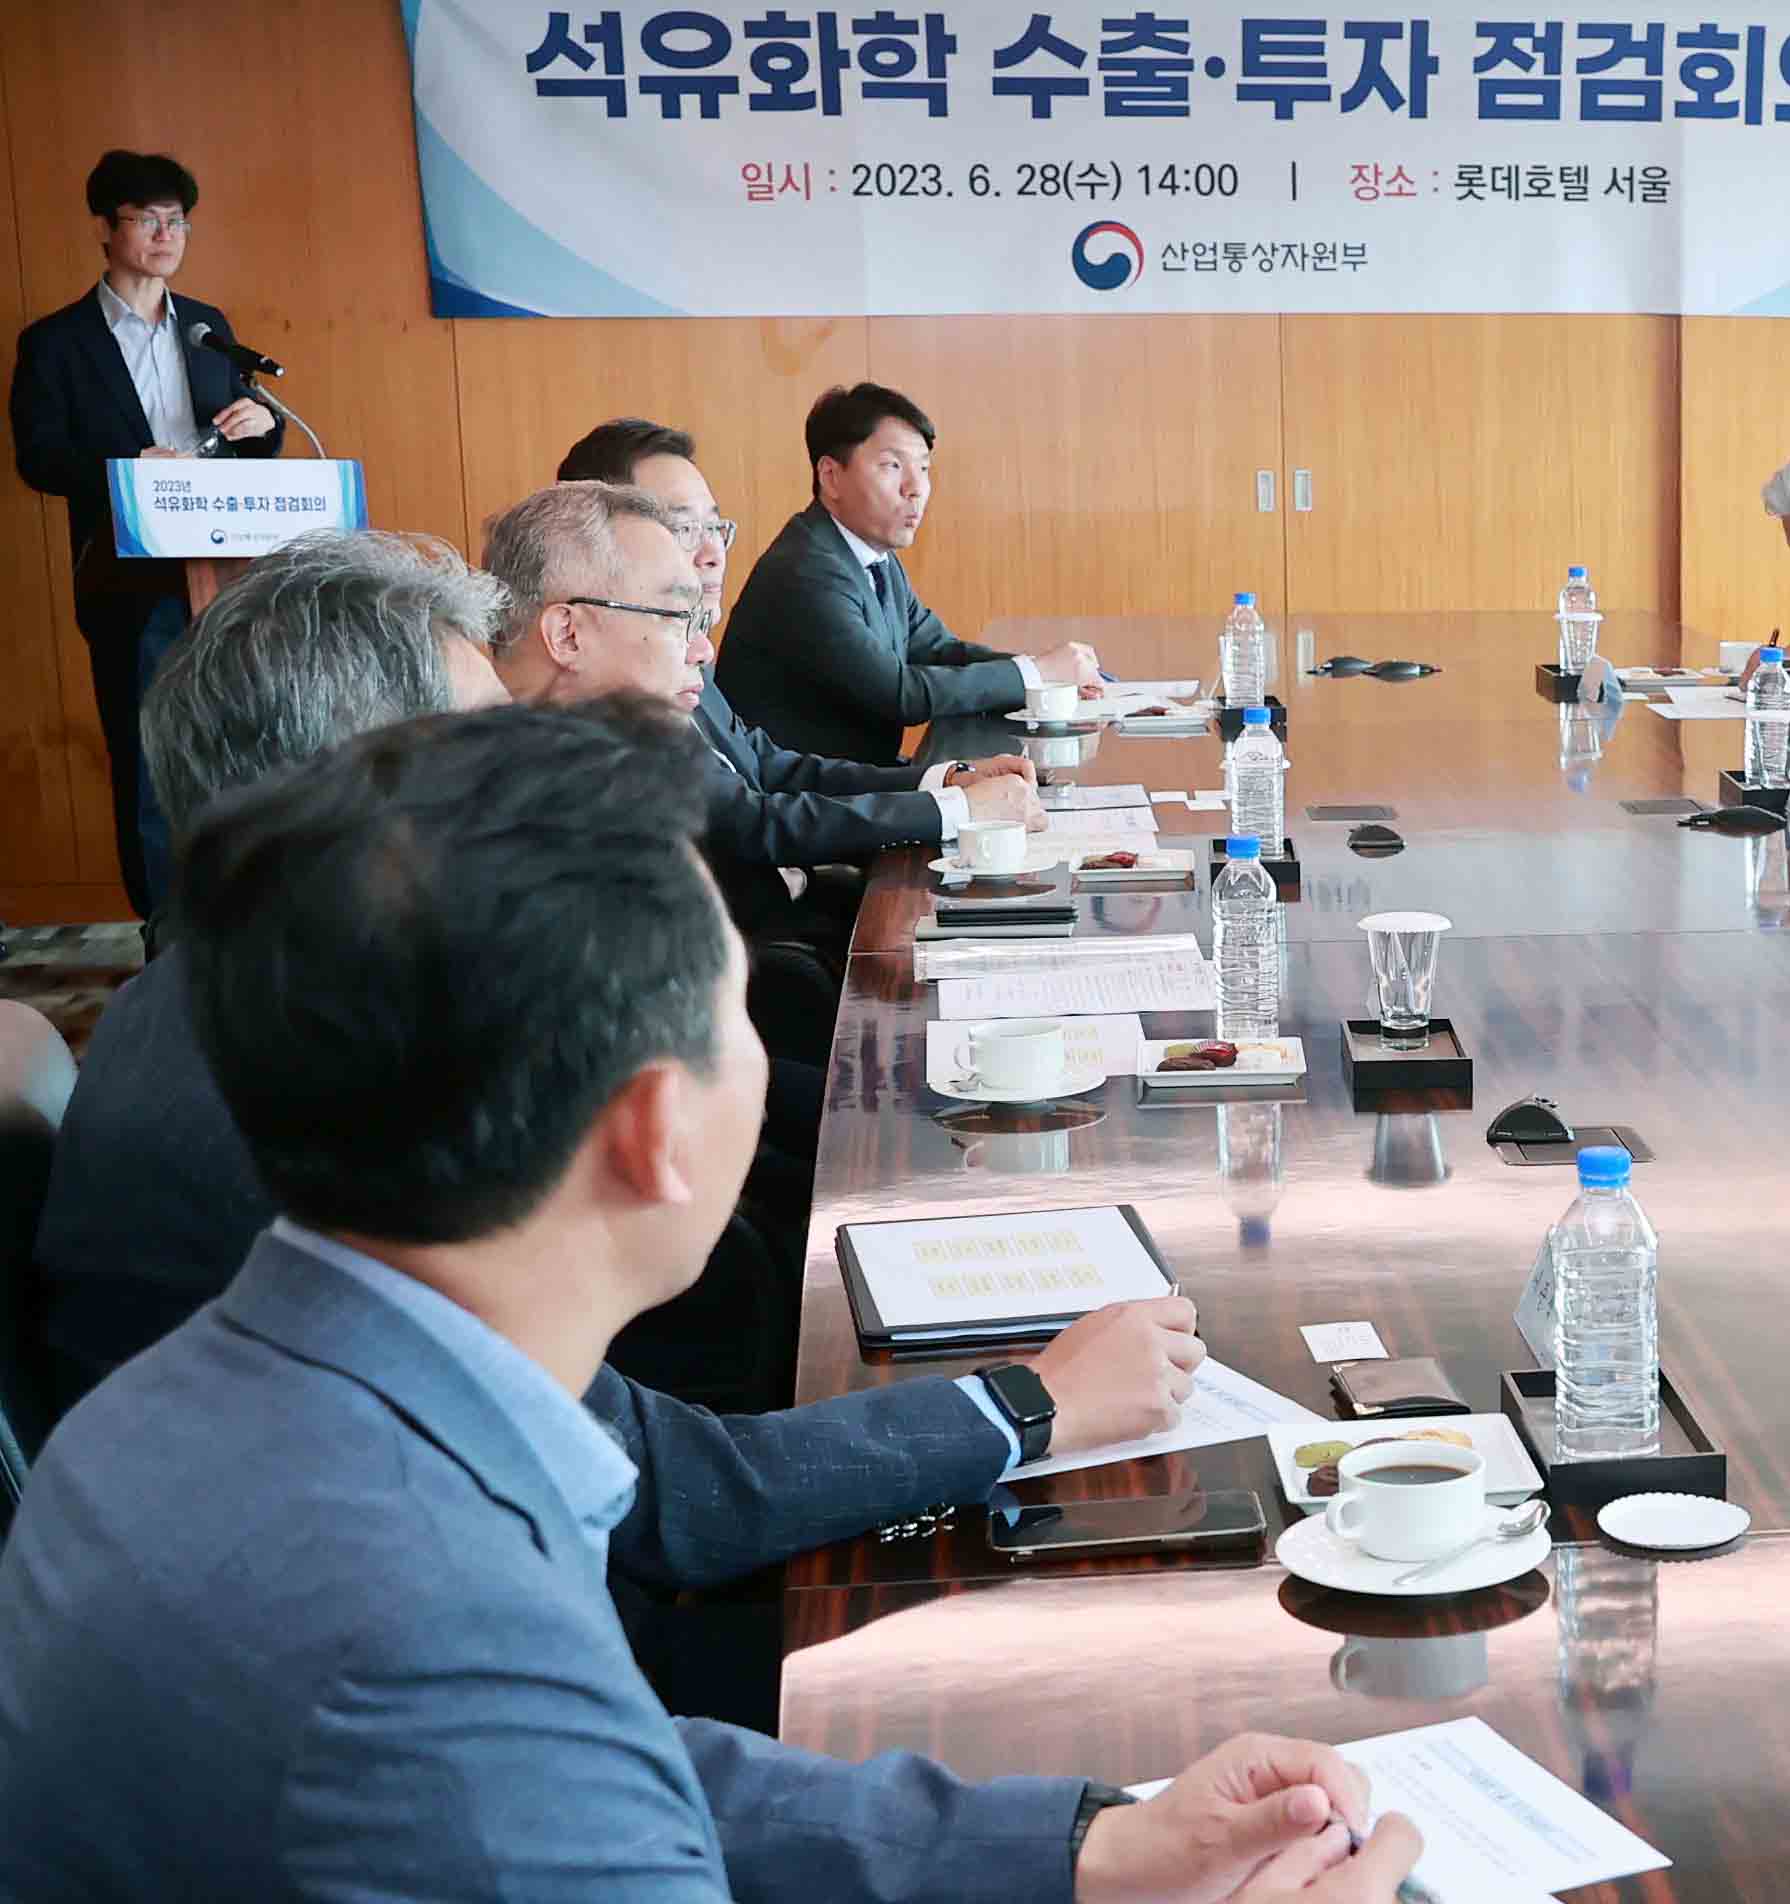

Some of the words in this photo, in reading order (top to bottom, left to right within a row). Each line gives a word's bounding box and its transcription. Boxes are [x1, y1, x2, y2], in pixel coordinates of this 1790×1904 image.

[525, 10, 958, 120] 석유화학
[991, 11, 1440, 121] 수출·투자
[741, 162, 811, 202] 일시
[851, 162, 954, 198] 2023.
[968, 163, 1001, 198] 6.
[1016, 159, 1123, 201] 28(수)
[1137, 163, 1239, 197] 14:00
[1350, 162, 1417, 201] 장소
[1453, 163, 1589, 203] 롯데호텔
[1602, 165, 1672, 204] 서울
[1160, 241, 1369, 274] 산업통상자원부
[152, 479, 192, 494] 2023년
[153, 495, 208, 513] 석유화학
[274, 495, 327, 513] 점검회의
